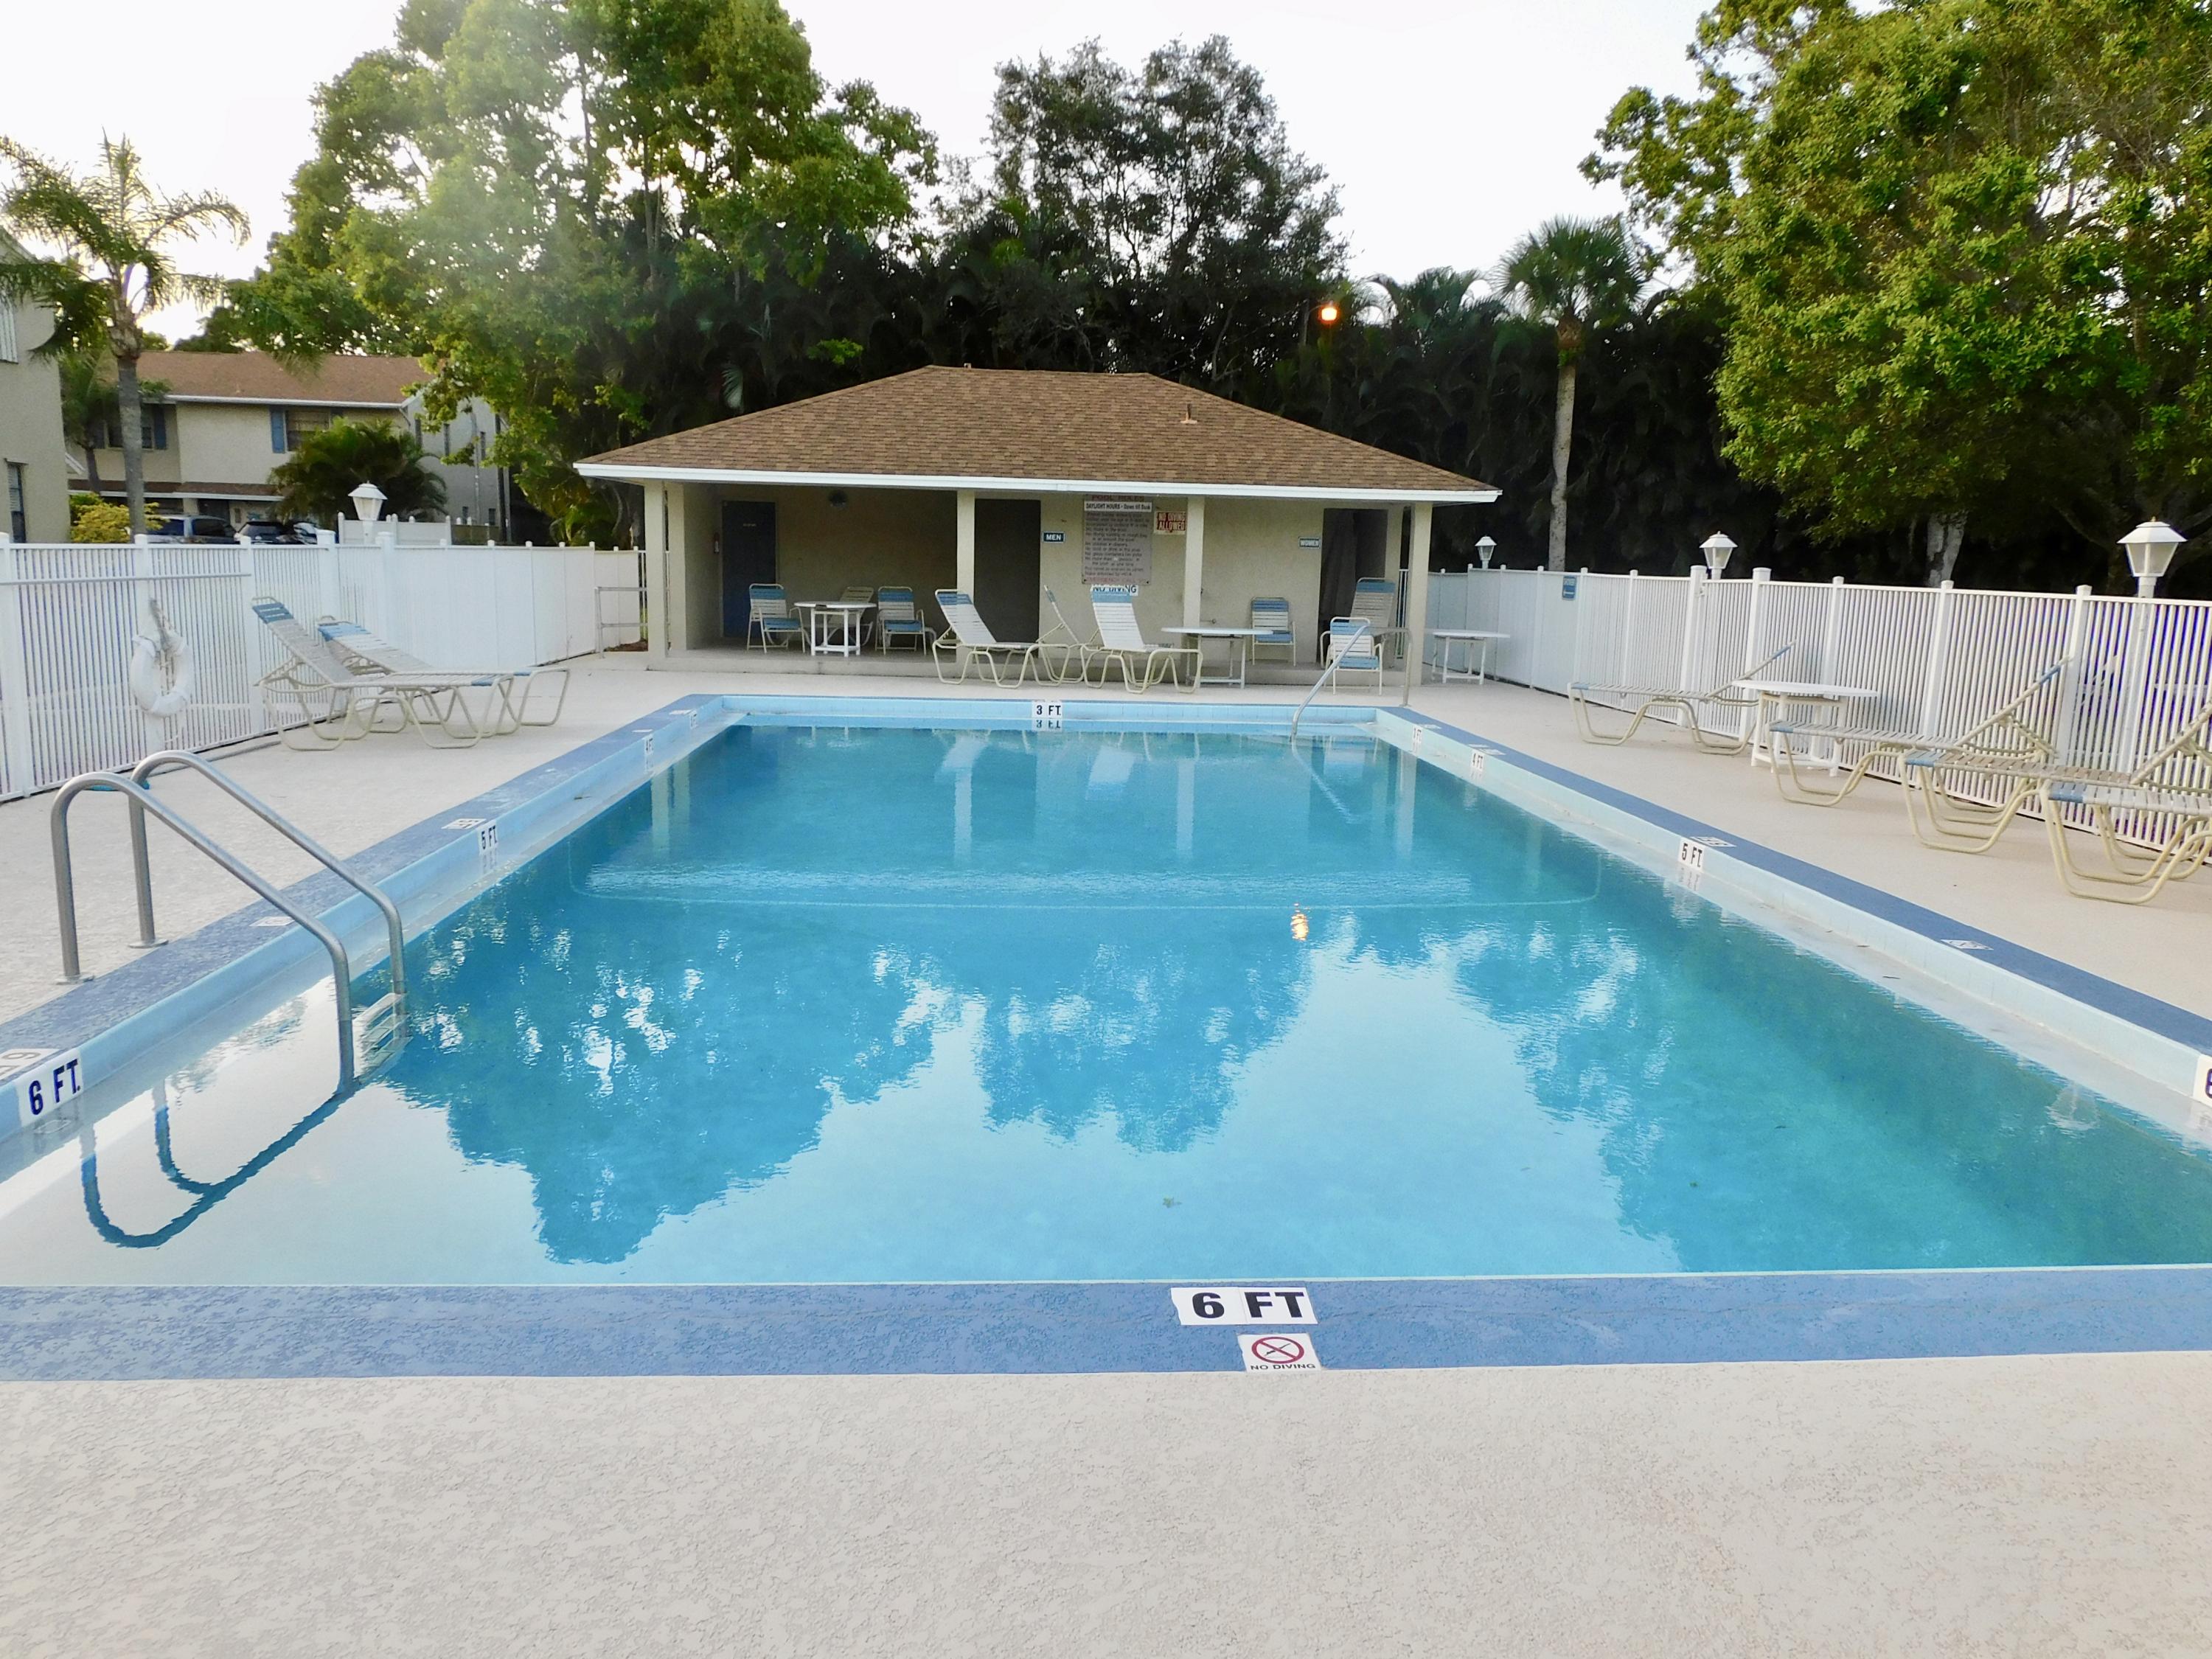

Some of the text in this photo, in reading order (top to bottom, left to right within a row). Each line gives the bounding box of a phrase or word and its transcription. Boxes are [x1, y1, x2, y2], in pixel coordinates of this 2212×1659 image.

[1158, 512, 1166, 521] NO
[1167, 512, 1186, 521] DIVING
[1158, 521, 1185, 530] ALLOWED
[1037, 705, 1043, 715] 3
[481, 830, 486, 850] 5
[1682, 843, 1688, 860] 5
[29, 1080, 44, 1115] 6
[1192, 1291, 1305, 1318] 6 FT
